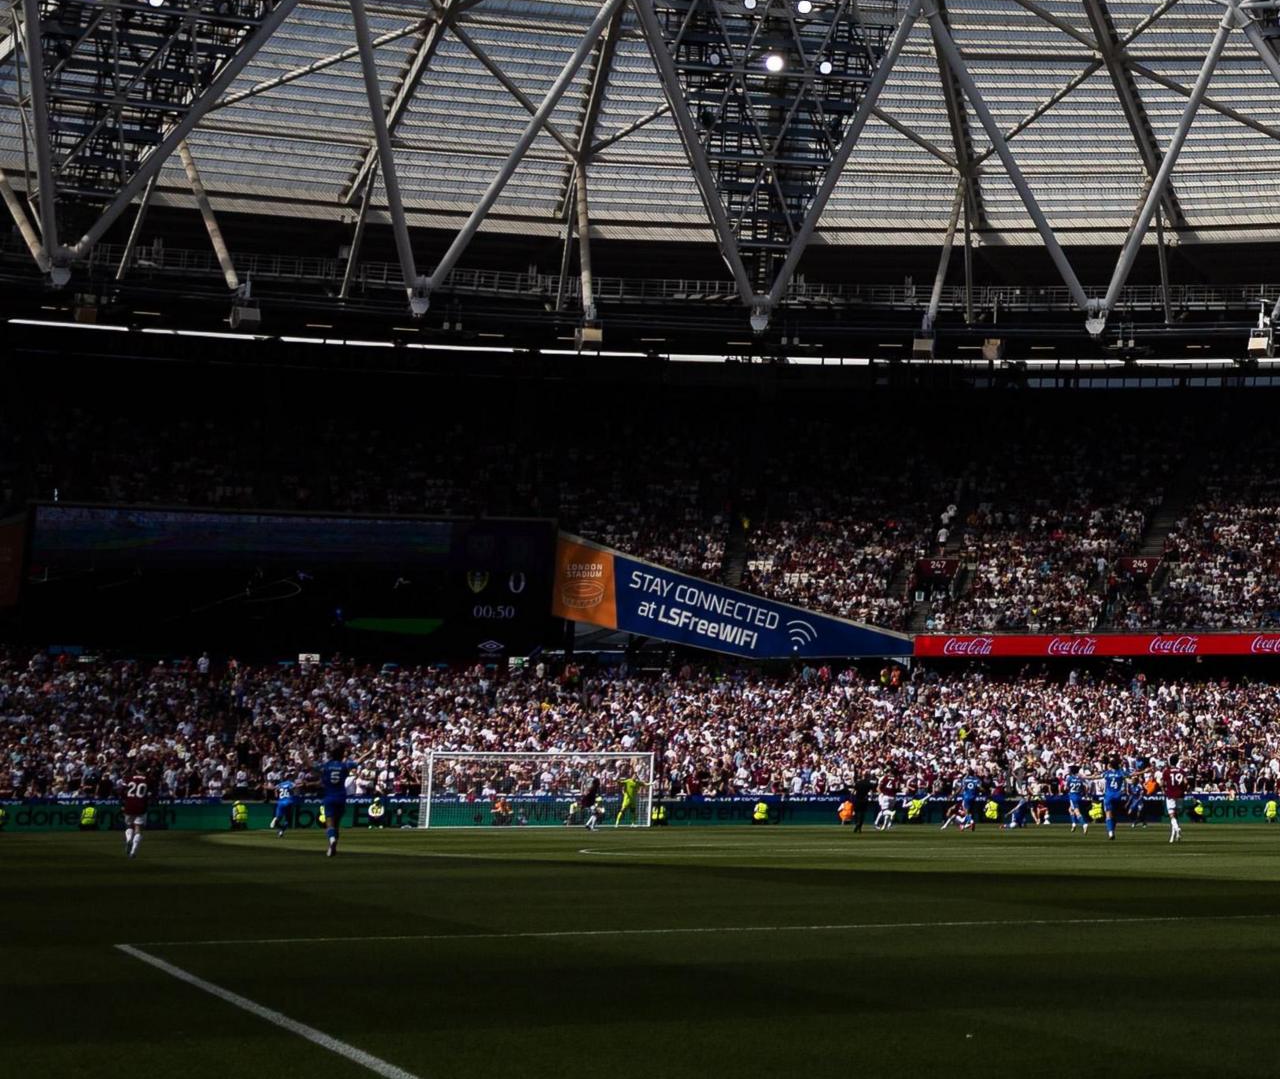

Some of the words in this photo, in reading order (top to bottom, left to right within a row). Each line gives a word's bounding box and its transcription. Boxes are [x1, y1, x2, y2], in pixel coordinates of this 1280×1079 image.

[566, 563, 603, 571] LONDON
[930, 560, 946, 569] 247
[1132, 560, 1148, 568] 246
[565, 570, 603, 578] STADIUM
[628, 571, 675, 598] STAY
[674, 584, 780, 630] CONNECTED
[473, 604, 516, 618] 00:50
[637, 601, 657, 619] at
[330, 771, 340, 784] 5
[1110, 779, 1118, 789] 4
[1170, 772, 1183, 785] 19
[127, 782, 148, 798] 20
[16, 807, 80, 826] done
